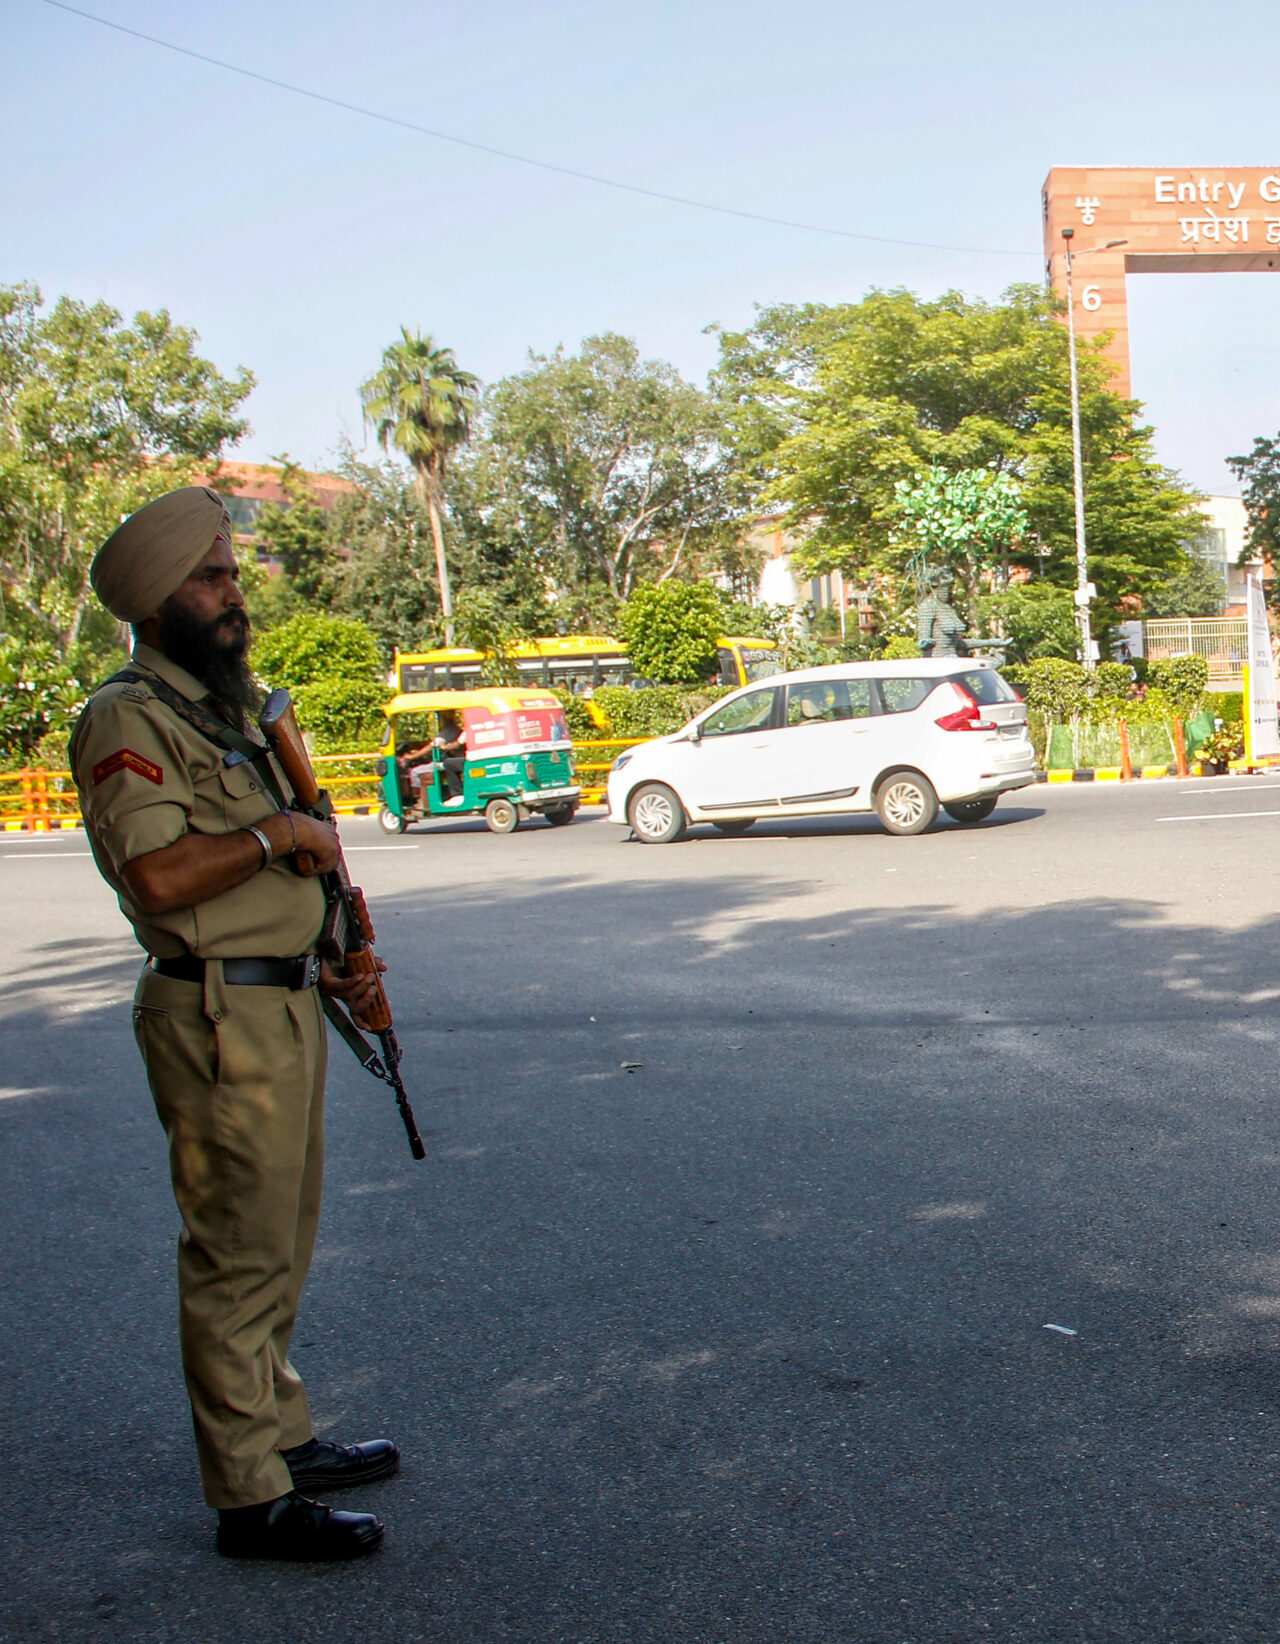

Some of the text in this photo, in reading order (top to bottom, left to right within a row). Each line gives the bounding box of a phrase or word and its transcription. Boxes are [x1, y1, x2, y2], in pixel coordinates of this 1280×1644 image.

[1155, 176, 1246, 210] Entry
[1178, 207, 1250, 243] प्रवेश
[1082, 284, 1101, 312] 6
